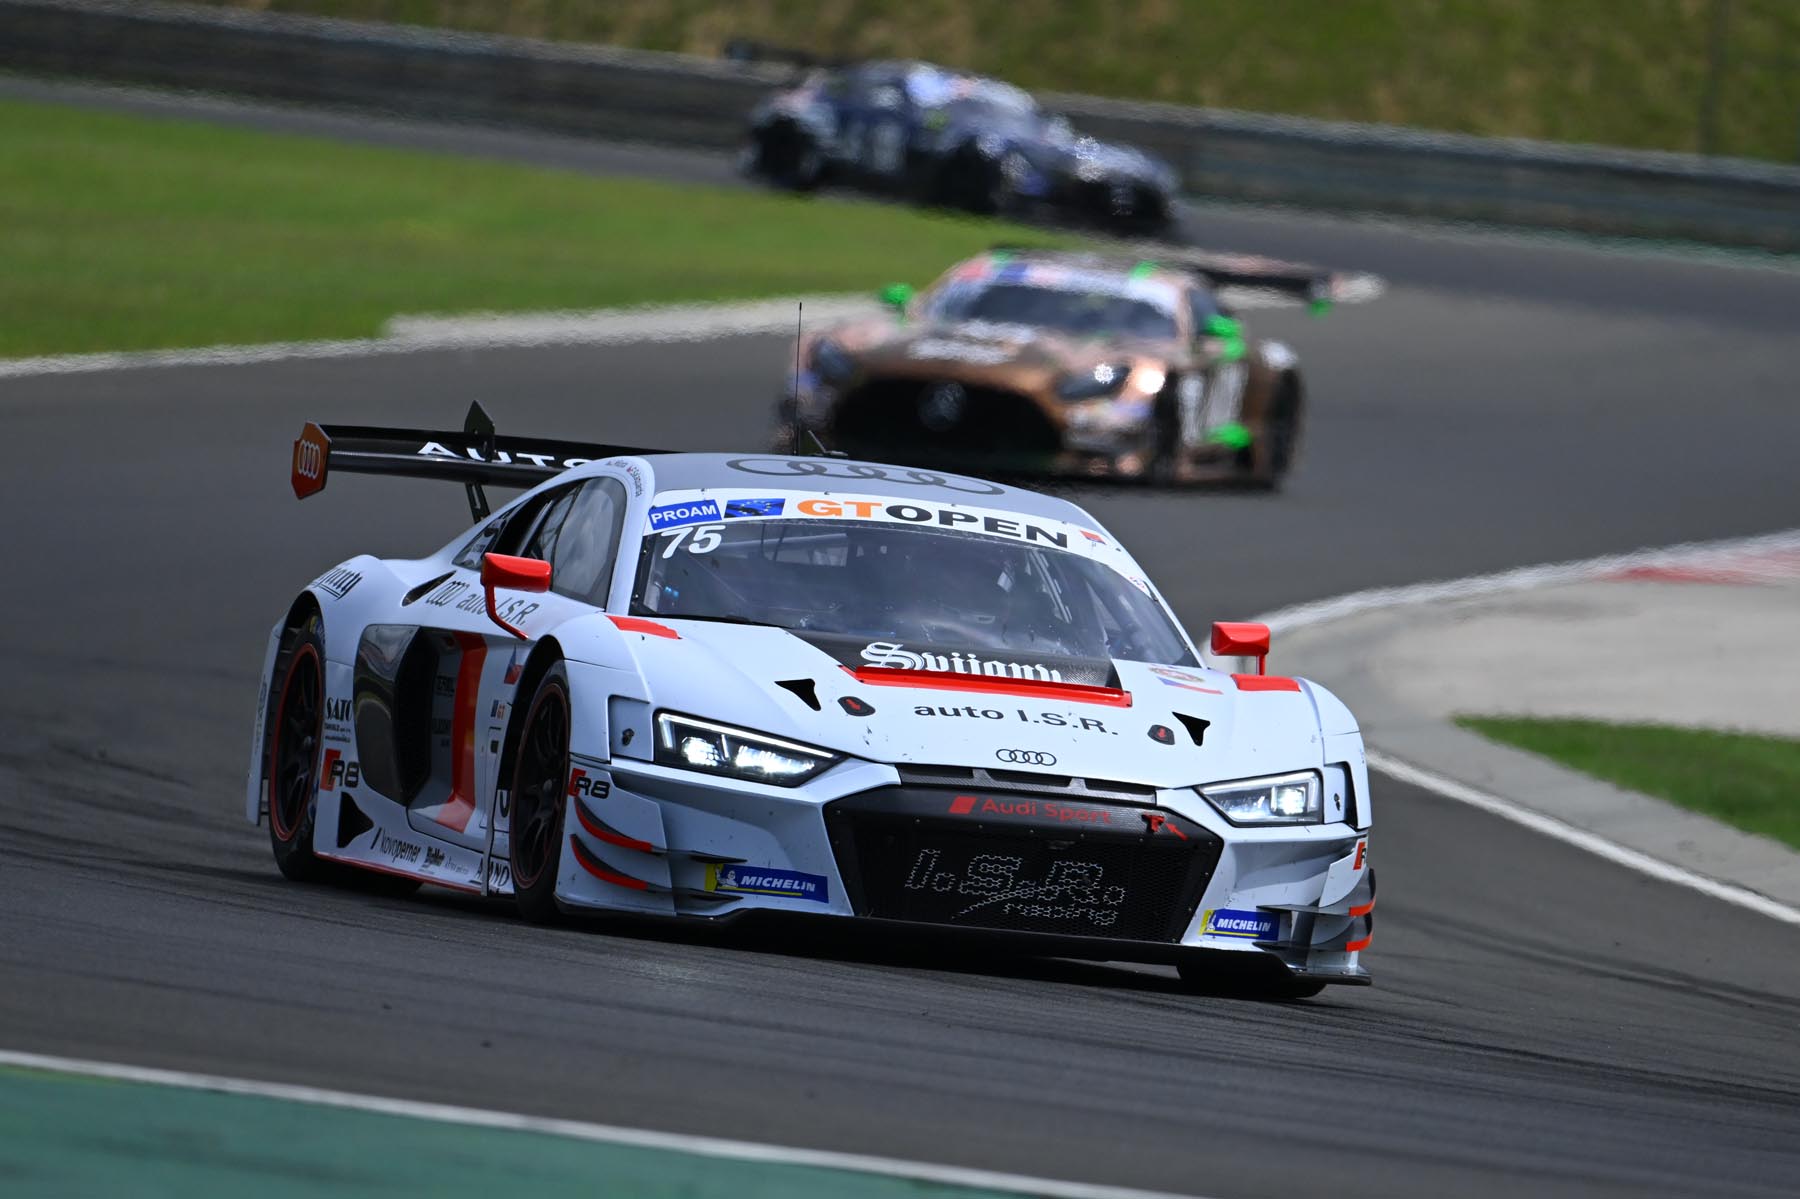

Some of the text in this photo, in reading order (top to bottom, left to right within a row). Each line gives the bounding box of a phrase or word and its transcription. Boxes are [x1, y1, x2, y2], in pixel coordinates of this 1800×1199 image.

[651, 505, 717, 524] PROAM
[661, 525, 726, 559] 75
[914, 705, 1119, 735] auto I.S.R.
[328, 760, 360, 788] R8
[575, 776, 610, 799] R8
[981, 799, 1113, 825] Audi Sport
[740, 875, 816, 892] MICHELIN
[1216, 918, 1272, 932] MICHELIN
